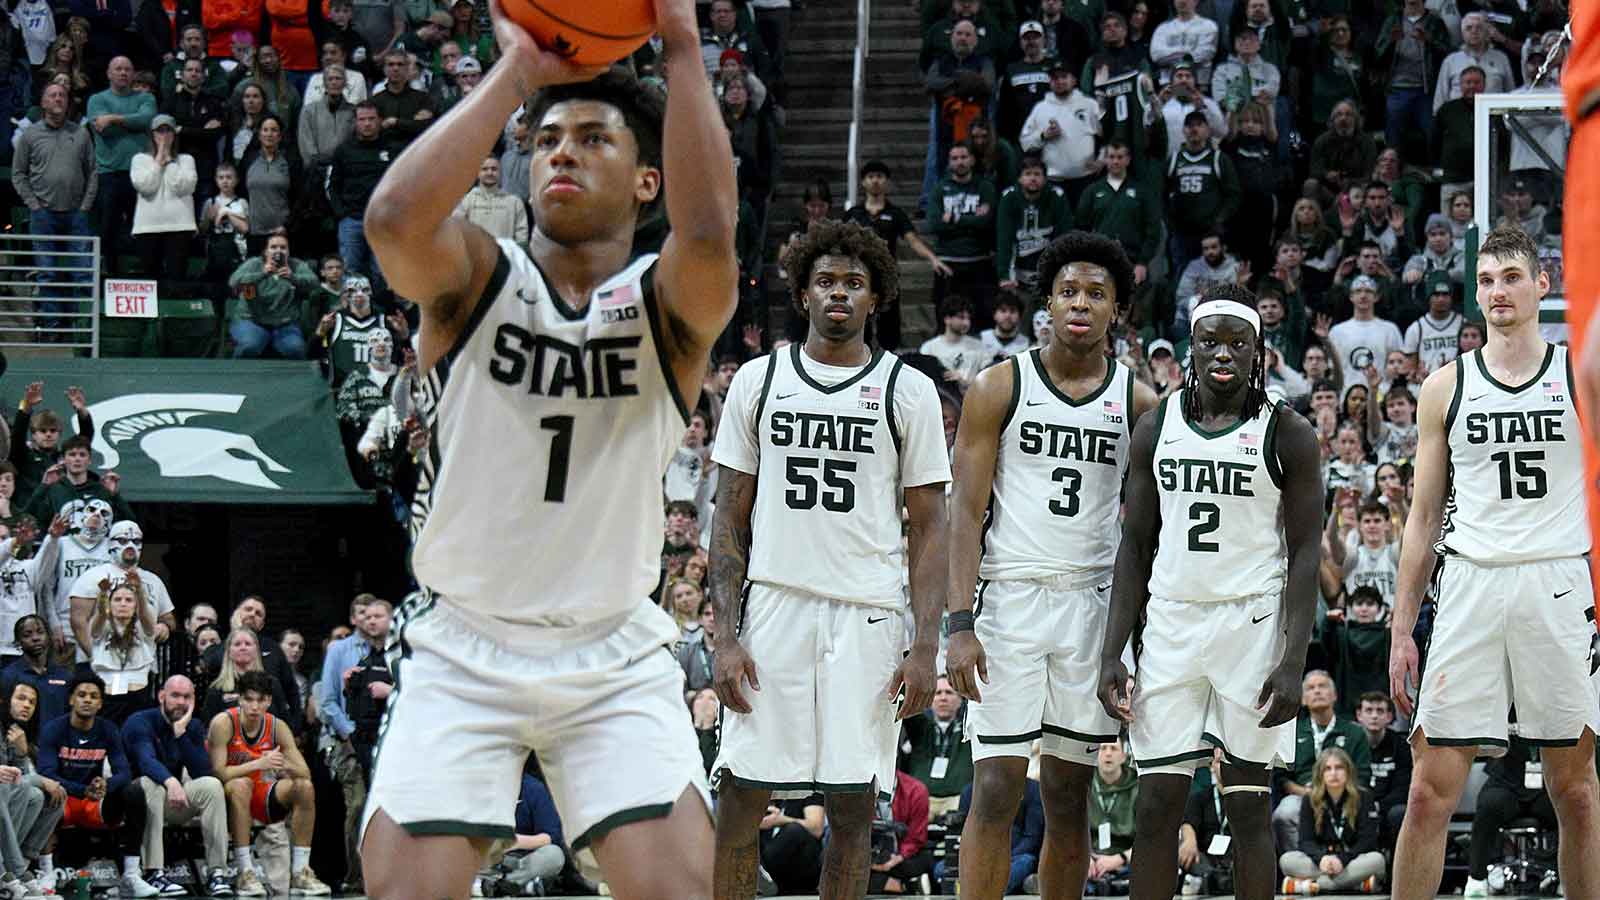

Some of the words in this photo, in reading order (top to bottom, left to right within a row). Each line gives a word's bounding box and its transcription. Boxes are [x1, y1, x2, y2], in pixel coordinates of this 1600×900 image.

[1115, 95, 1128, 121] 0
[1180, 176, 1202, 193] 55
[107, 283, 155, 293] EMERGENCY
[115, 296, 148, 314] EXIT
[489, 323, 642, 399] STATE
[1424, 336, 1457, 351] STATE
[771, 411, 879, 454] STATE
[1020, 421, 1121, 466] STATE
[1466, 410, 1566, 444] STATE
[540, 415, 575, 502] 1
[1159, 458, 1258, 497] STATE
[1491, 451, 1548, 499] 15
[785, 456, 857, 513] 55
[1048, 467, 1082, 517] 3
[1188, 502, 1220, 552] 2
